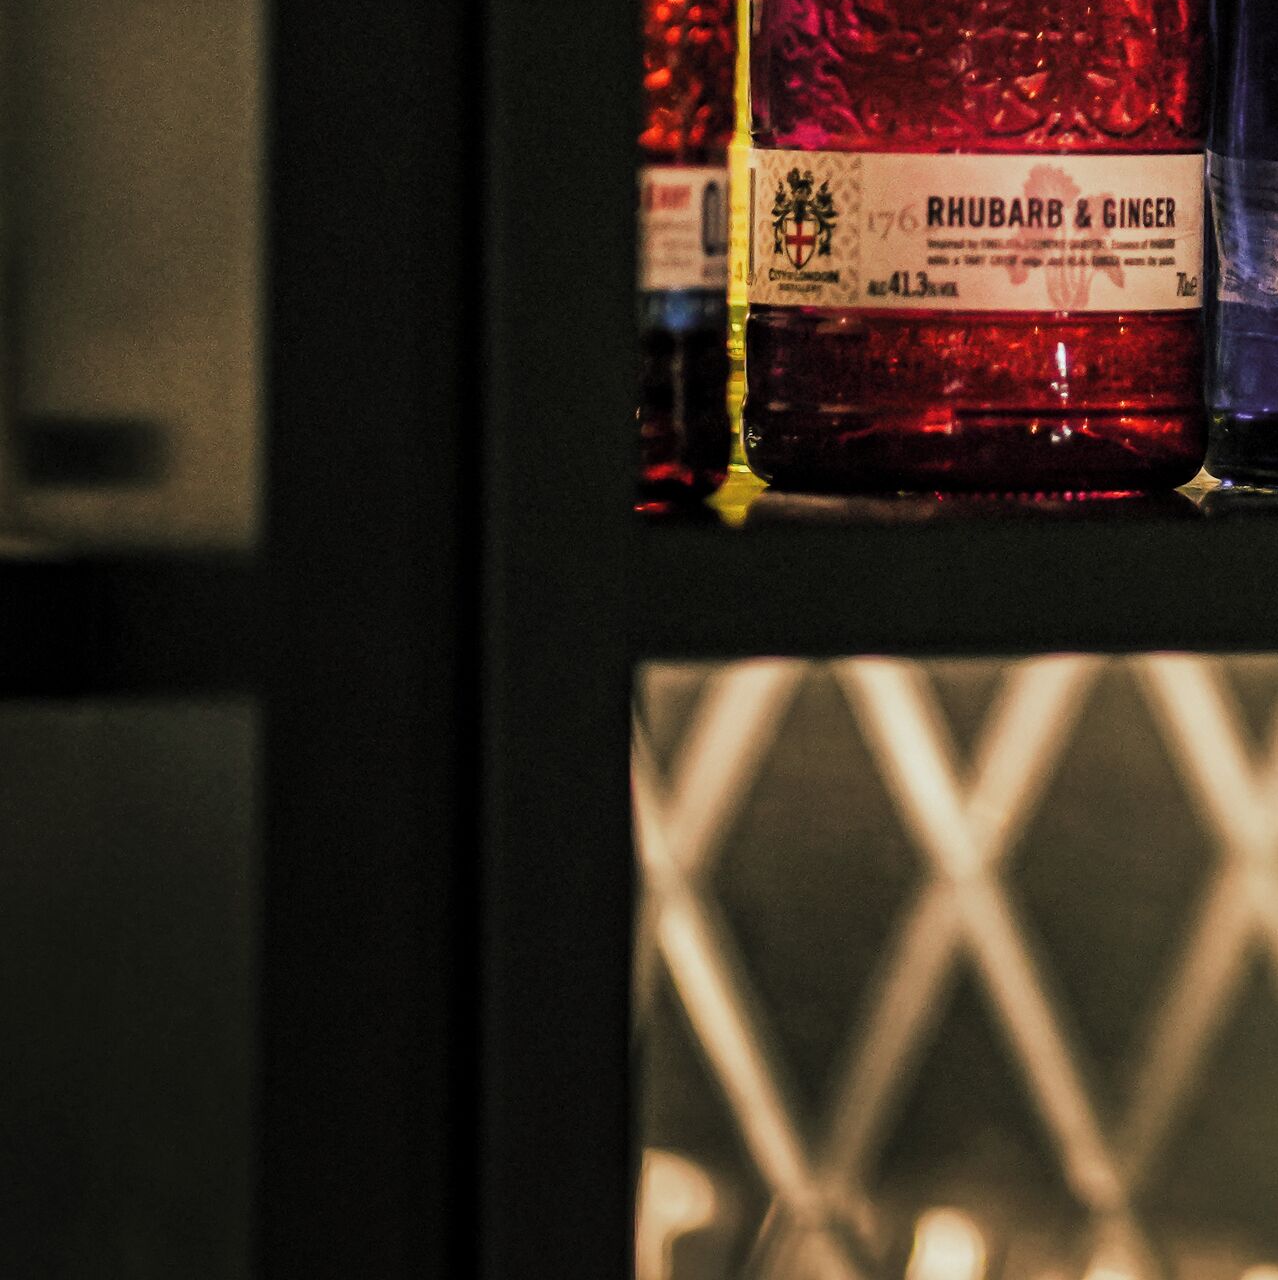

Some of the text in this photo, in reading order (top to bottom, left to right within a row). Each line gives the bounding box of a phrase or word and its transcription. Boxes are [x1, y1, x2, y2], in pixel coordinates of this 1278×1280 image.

[926, 195, 1176, 229] RHUBARB & GINGER
